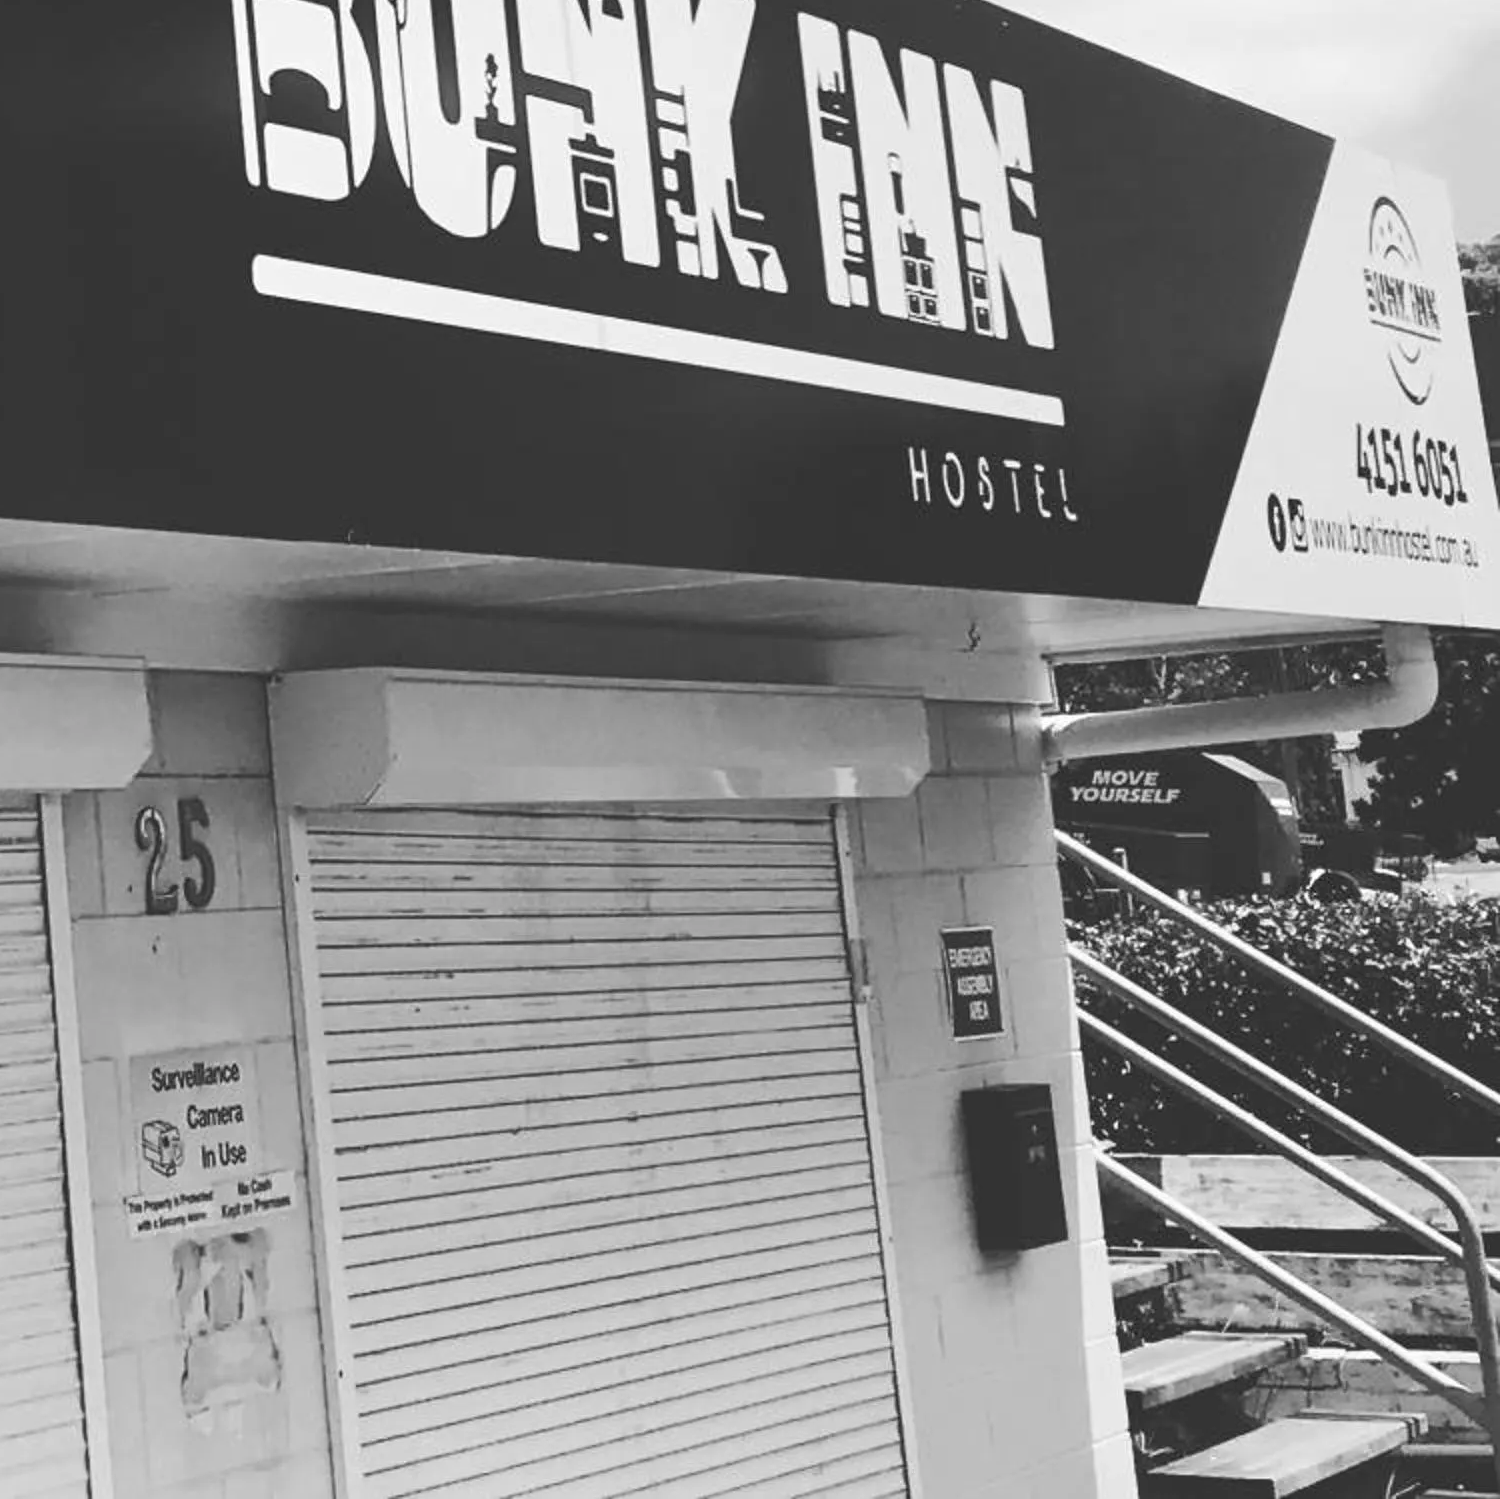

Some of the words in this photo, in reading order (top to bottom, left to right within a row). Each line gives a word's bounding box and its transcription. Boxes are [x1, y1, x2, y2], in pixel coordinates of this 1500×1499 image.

[798, 11, 1055, 350] INN
[1356, 422, 1412, 497] 4151
[1413, 428, 1468, 507] 6051
[908, 446, 1079, 522] HOSTEL
[1092, 769, 1160, 787] MOVE
[1069, 787, 1181, 804] YOURSELF
[134, 796, 216, 916] 25
[151, 1062, 241, 1093] Surveillance
[187, 1103, 244, 1130] Camera
[200, 1146, 217, 1169] In
[218, 1141, 247, 1167] Use
